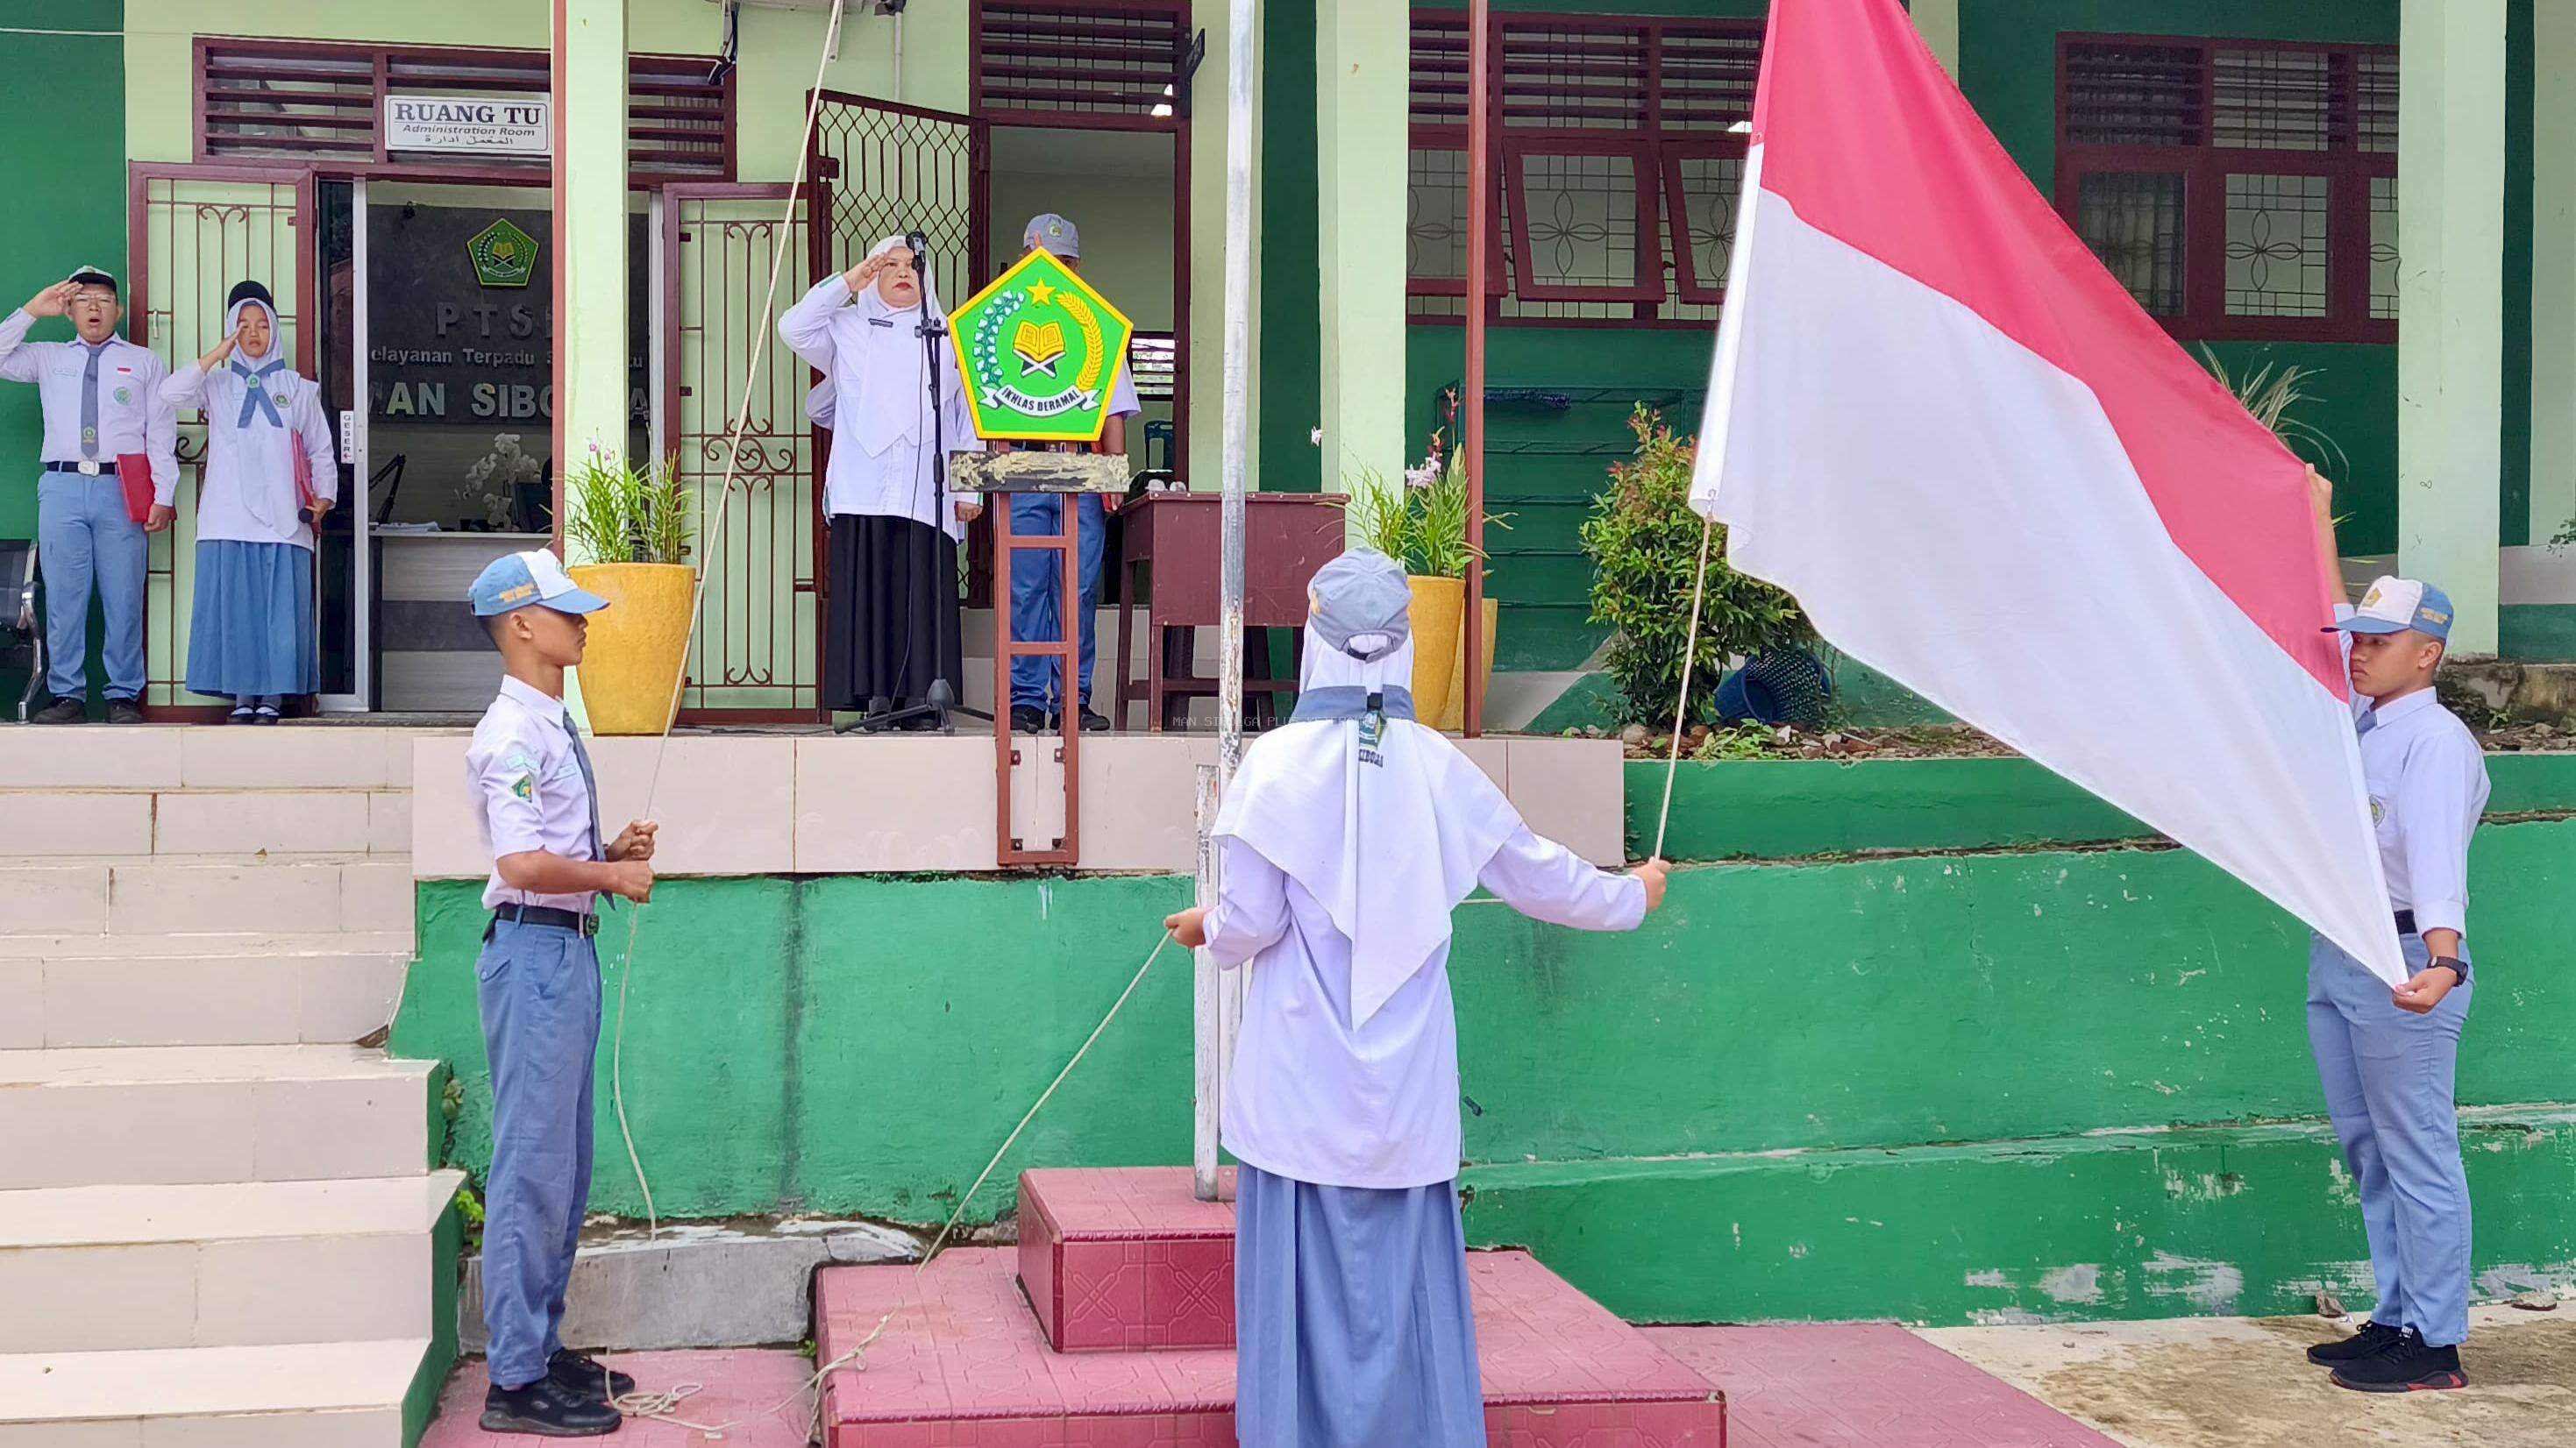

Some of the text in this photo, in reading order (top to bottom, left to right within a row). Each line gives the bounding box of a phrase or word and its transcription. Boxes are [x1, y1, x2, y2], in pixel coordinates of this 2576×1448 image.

[395, 103, 541, 125] RUANG TU
[402, 124, 536, 137] Administration Room
[371, 345, 452, 366] elayanan
[463, 348, 536, 368] Terpadu
[1001, 387, 1081, 412] IKHLAS BERAMAL
